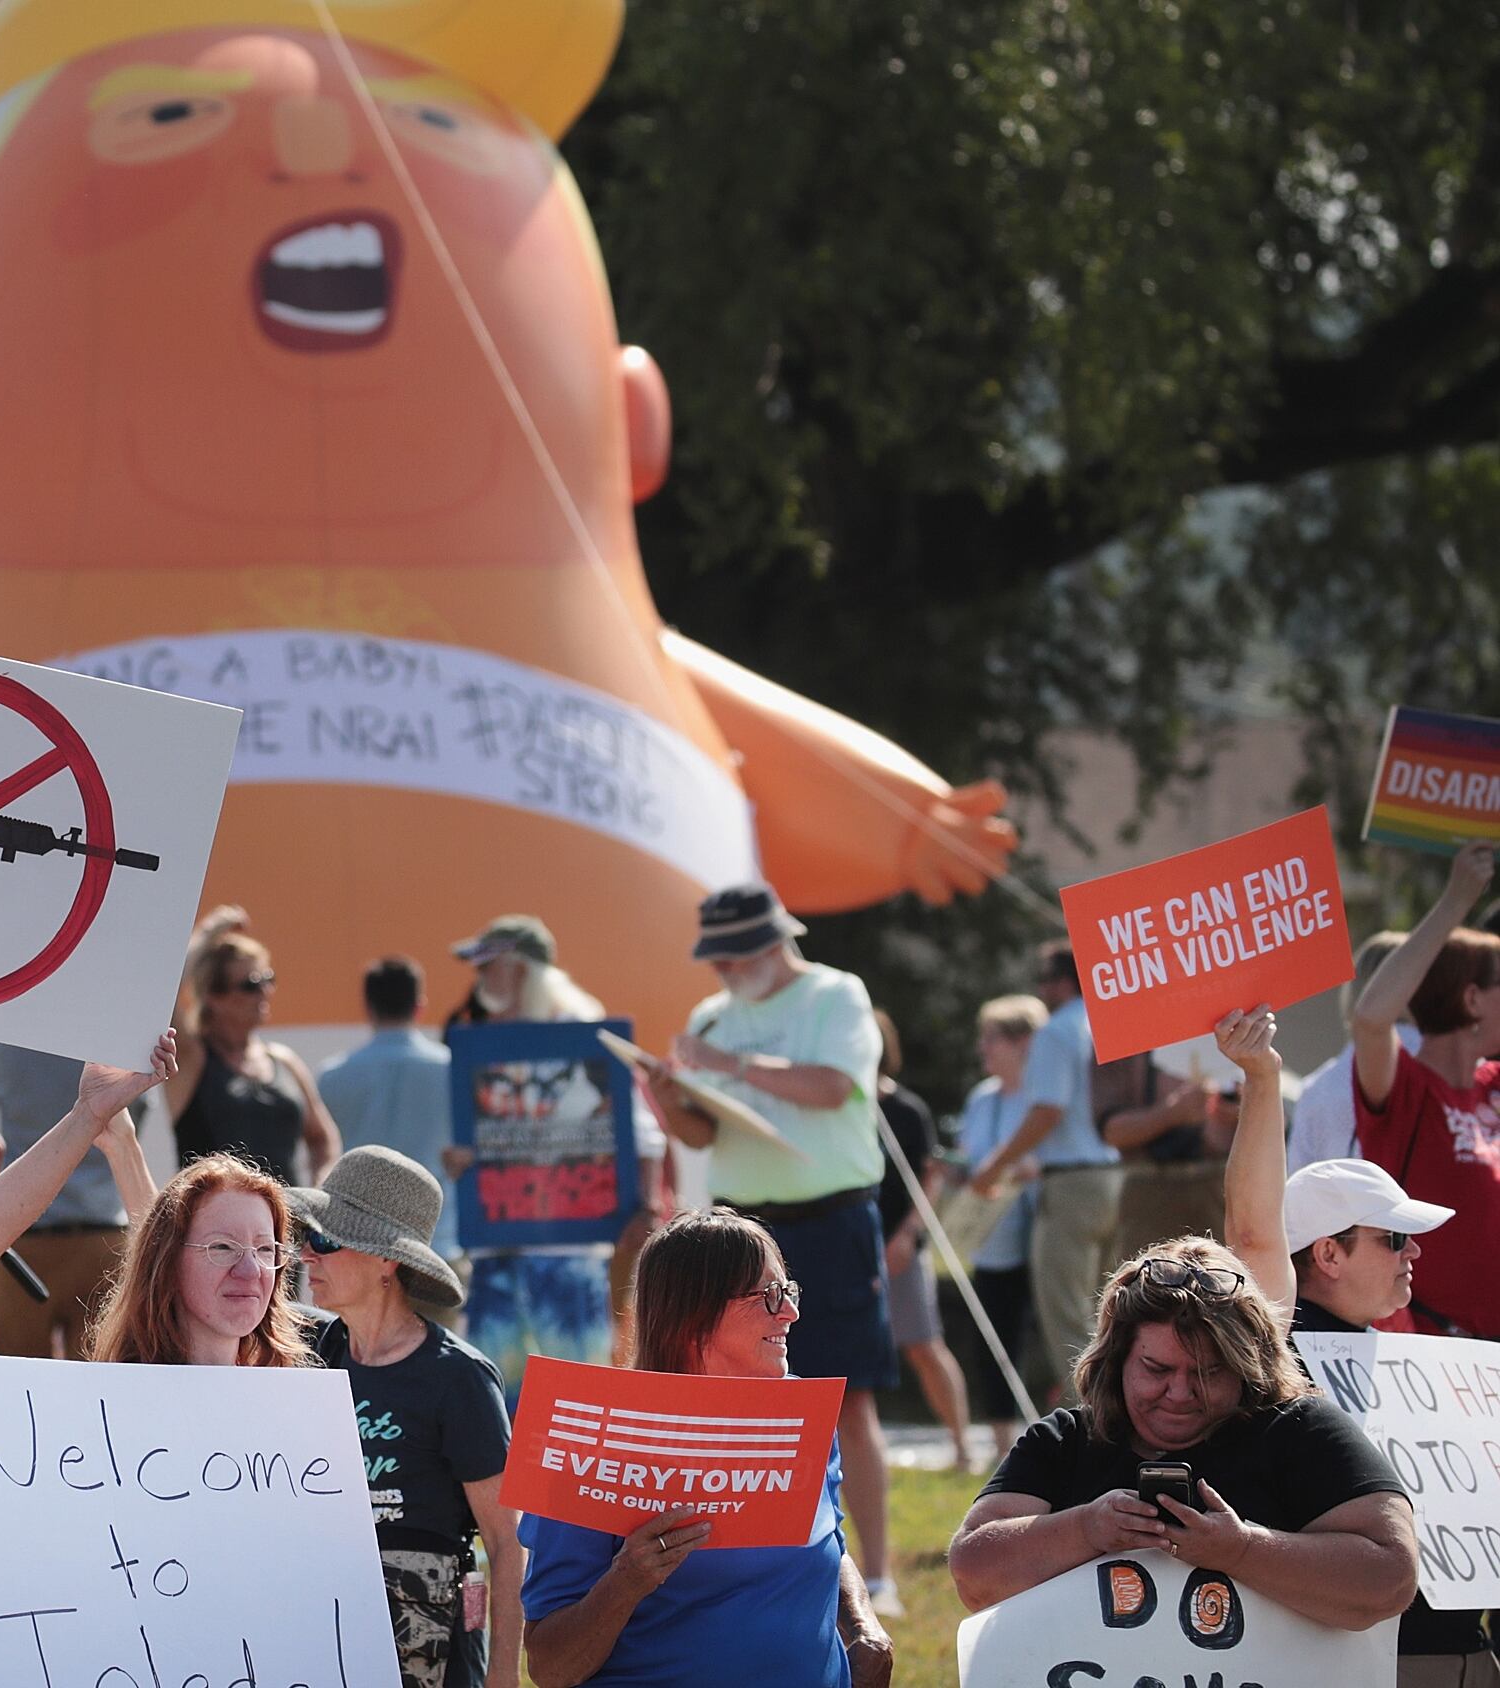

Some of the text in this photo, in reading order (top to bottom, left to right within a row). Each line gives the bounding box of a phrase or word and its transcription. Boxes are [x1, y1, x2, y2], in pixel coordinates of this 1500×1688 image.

[209, 648, 248, 687] A
[1098, 857, 1309, 954] WE CAN END
[1091, 889, 1333, 1000] GUN VIOLENCE
[1320, 1357, 1382, 1414] NO
[1377, 1358, 1438, 1414] TO
[541, 1446, 794, 1493] EVERYTOWN
[1415, 1439, 1478, 1494] TO
[578, 1485, 618, 1504] FOR
[622, 1495, 667, 1513] GUN
[109, 1523, 189, 1599] to
[1418, 1523, 1476, 1582] NO
[1096, 1558, 1245, 1651] DO
